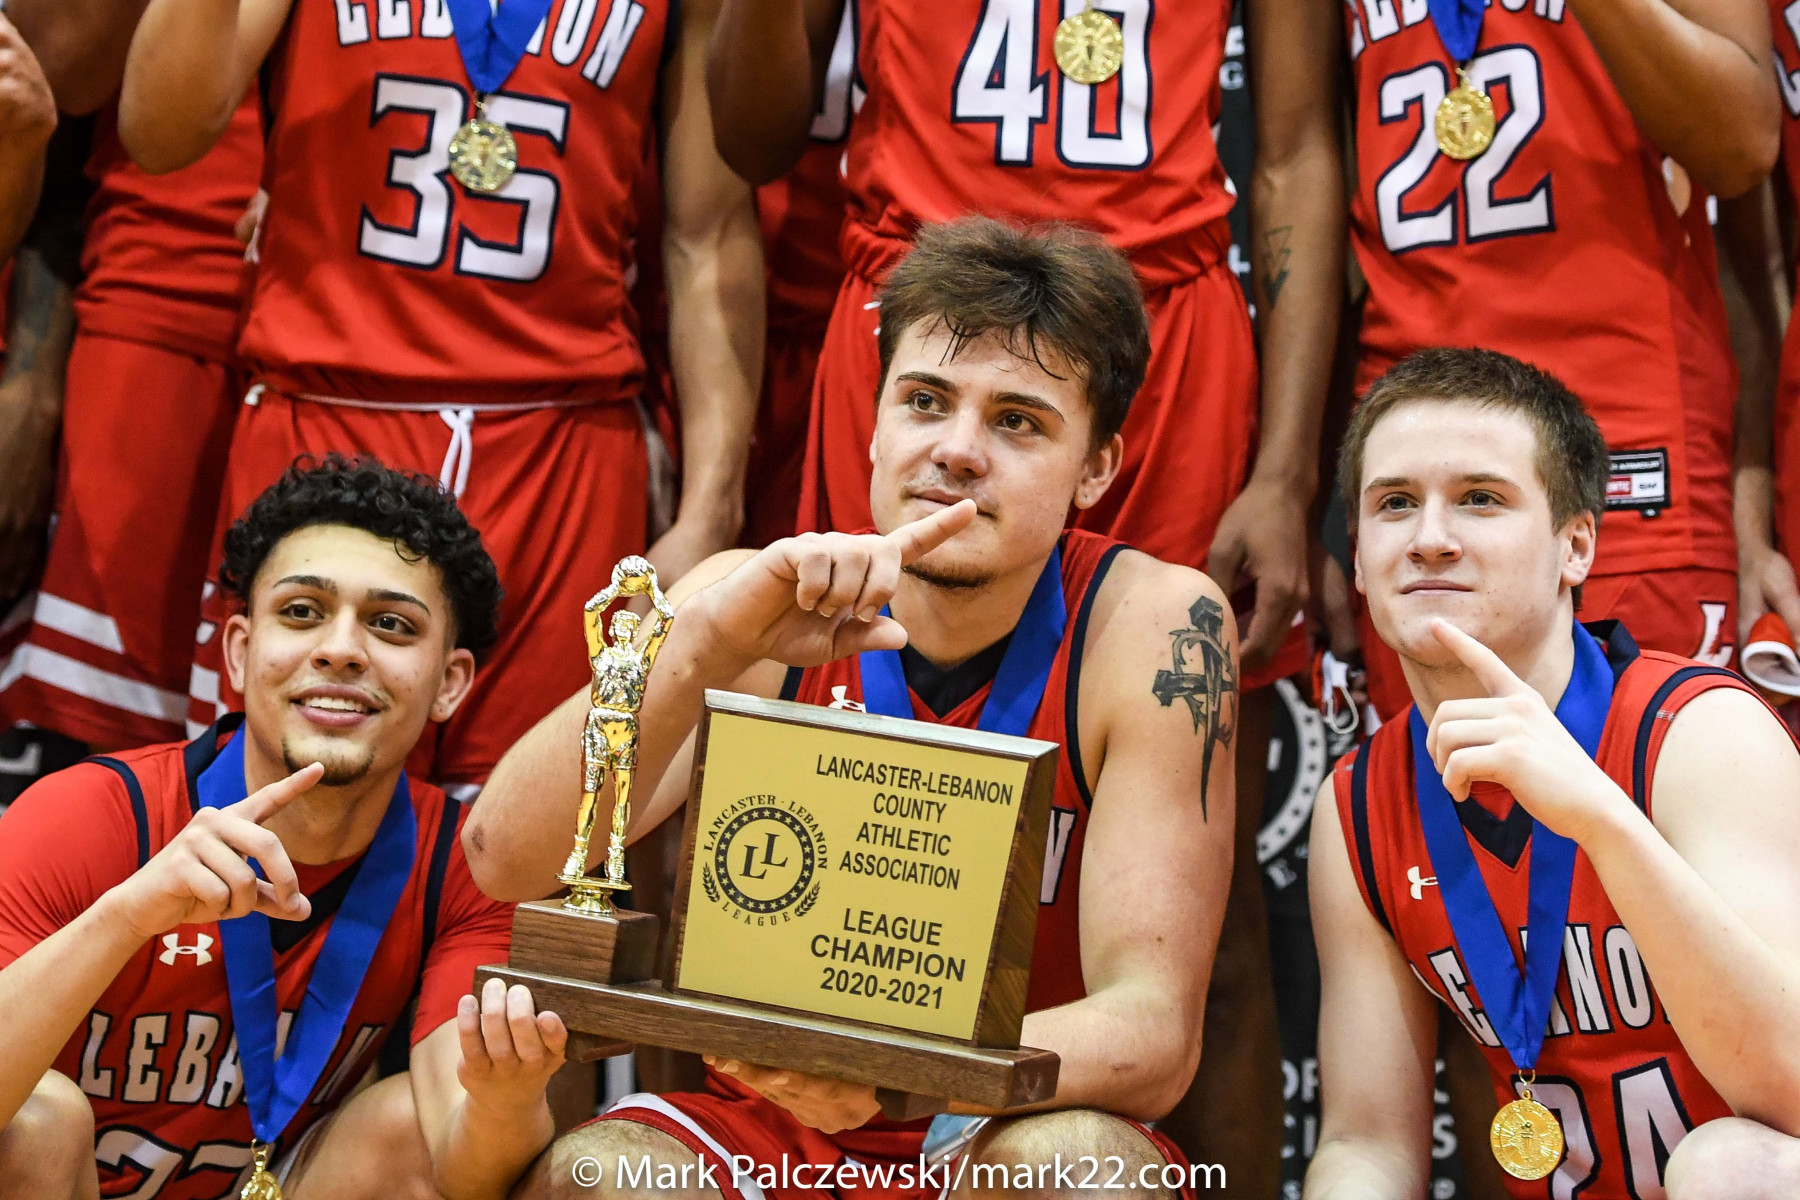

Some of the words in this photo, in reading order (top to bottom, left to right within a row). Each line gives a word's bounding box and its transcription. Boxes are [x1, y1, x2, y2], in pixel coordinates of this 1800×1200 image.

[335, 0, 645, 90] LEBON
[952, 0, 1153, 171] 40
[1376, 43, 1556, 255] 22
[358, 72, 570, 283] 35
[816, 754, 1014, 806] LANCASTER-LEBANON
[703, 794, 777, 852] LANCASTER
[788, 801, 829, 870] LEBANON
[873, 792, 947, 824] COUNTY
[856, 822, 952, 856] ATHLETIC
[839, 850, 961, 890] ASSOCIATION
[721, 901, 791, 927] LEAGUE
[843, 908, 943, 947] LEAGUE
[811, 934, 967, 982] CHAMPION
[820, 967, 943, 1010] 2020-2021
[77, 1009, 386, 1110] LEBAN
